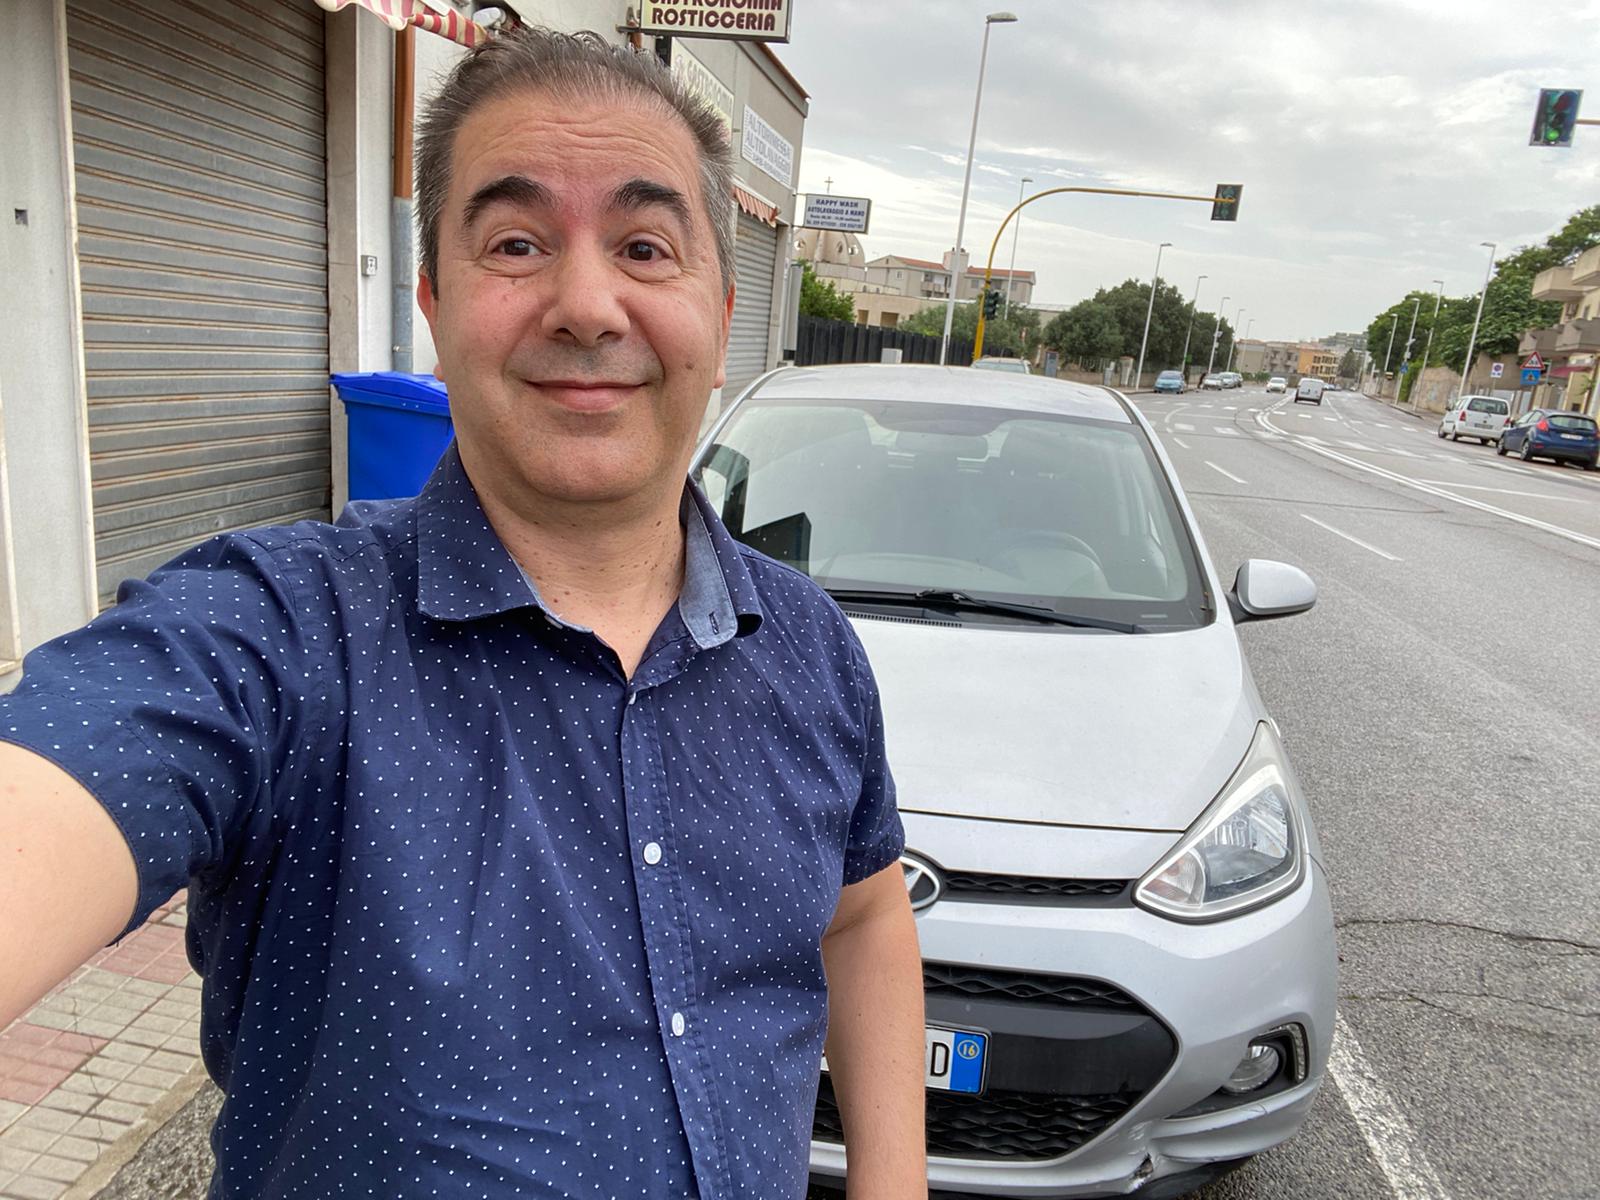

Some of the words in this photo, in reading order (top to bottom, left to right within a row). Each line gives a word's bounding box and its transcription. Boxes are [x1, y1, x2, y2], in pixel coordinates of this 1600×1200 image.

[652, 8, 775, 31] ROSTICCERIA
[816, 199, 838, 207] HAPPY
[963, 1043, 976, 1057] 16
